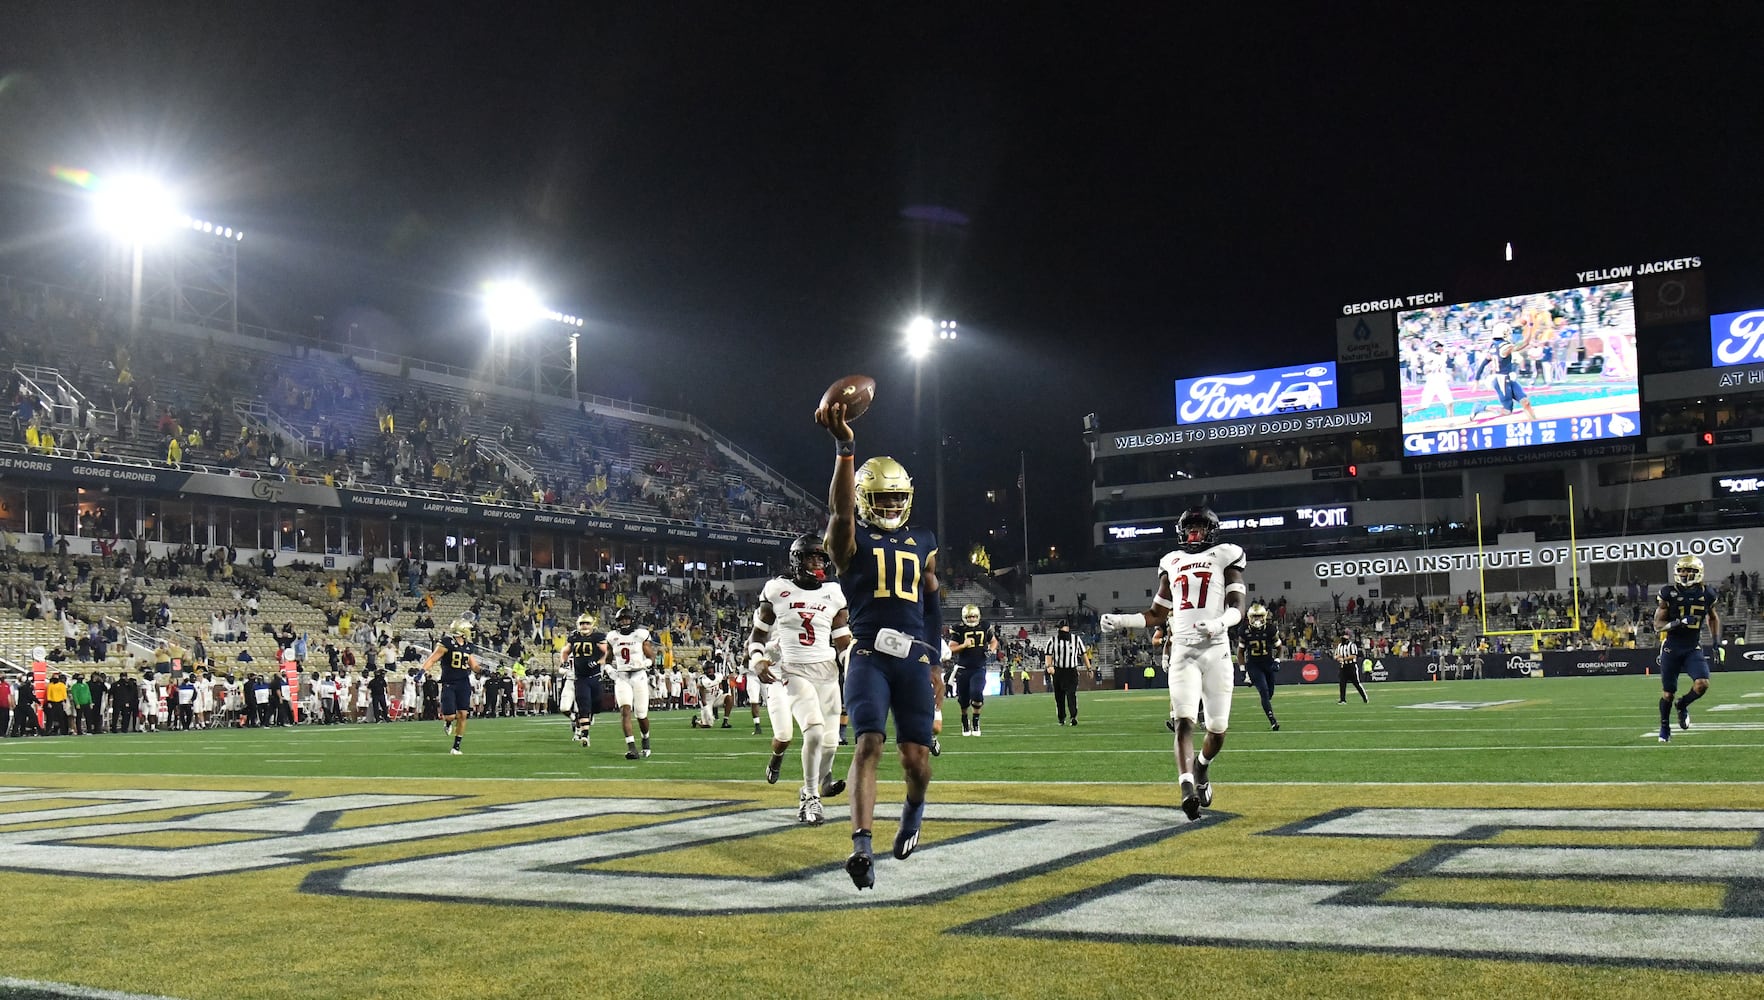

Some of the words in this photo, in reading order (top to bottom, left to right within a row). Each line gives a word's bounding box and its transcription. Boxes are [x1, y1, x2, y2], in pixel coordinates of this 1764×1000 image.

[1576, 265, 1633, 283] YELLOW
[1637, 256, 1702, 276] JACKETS
[1342, 298, 1403, 316] GEORGIA
[1406, 291, 1444, 307] TECH
[1719, 372, 1744, 387] AT
[1180, 374, 1281, 422] Ford
[1115, 432, 1183, 449] WELCOME
[1185, 429, 1205, 442] TO
[1208, 424, 1256, 440] BOBBY
[1260, 419, 1302, 434] DODD
[1305, 411, 1372, 430] STADIUM
[1506, 422, 1533, 438] 6:34
[1580, 417, 1601, 439] 21
[1437, 430, 1459, 451] 20
[1704, 432, 1713, 444] 9
[13, 459, 52, 472] MORRIS
[1463, 454, 1514, 466] NATIONAL
[1516, 448, 1577, 462] CHAMPIONS
[72, 466, 111, 478] GEORGE
[113, 470, 157, 483] GARDNER
[351, 495, 373, 505] MAXIE
[374, 497, 408, 508] BAUGHAN
[423, 503, 444, 512] LARRY
[444, 505, 468, 514] MORRIS
[483, 509, 502, 518] BOBBY
[503, 511, 521, 520] DODD
[534, 514, 553, 523] BOBBY
[554, 516, 576, 525] GASTON
[1314, 557, 1410, 578] GEORGIA
[1414, 550, 1532, 573] INSTITUTE
[1538, 547, 1569, 566] OF
[1576, 535, 1744, 563] TECHNOLOGY
[872, 547, 921, 603] 10
[797, 611, 816, 646] 3
[964, 631, 985, 648] 67
[1249, 640, 1269, 656] 21
[573, 641, 593, 658] 70
[620, 647, 630, 664] 9
[451, 651, 470, 670] 83
